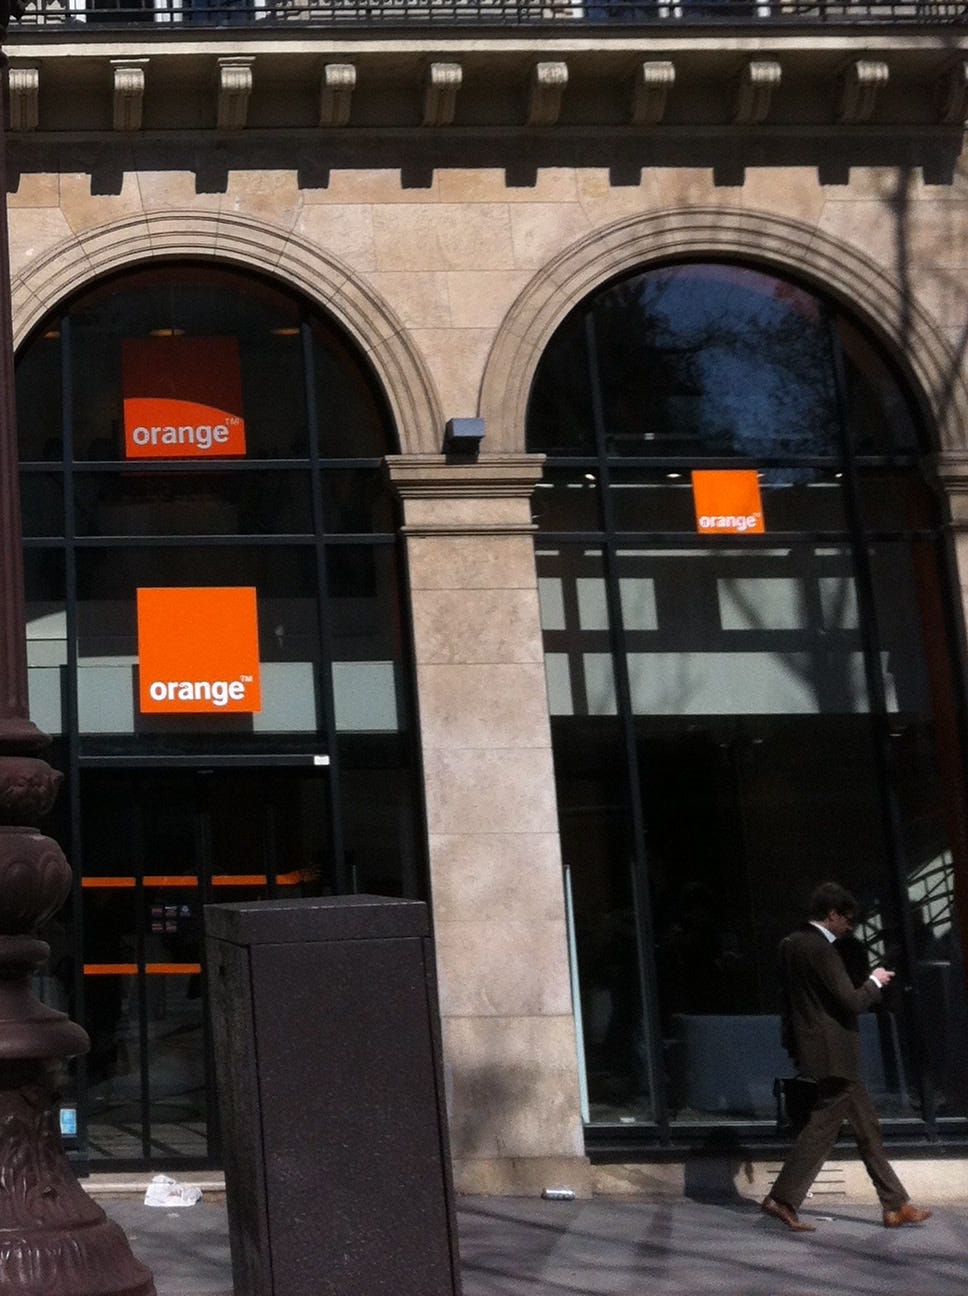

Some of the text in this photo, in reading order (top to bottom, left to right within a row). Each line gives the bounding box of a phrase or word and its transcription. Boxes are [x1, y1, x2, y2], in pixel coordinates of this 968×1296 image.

[133, 424, 229, 450] orange
[699, 515, 757, 532] orange
[149, 680, 246, 706] orange
